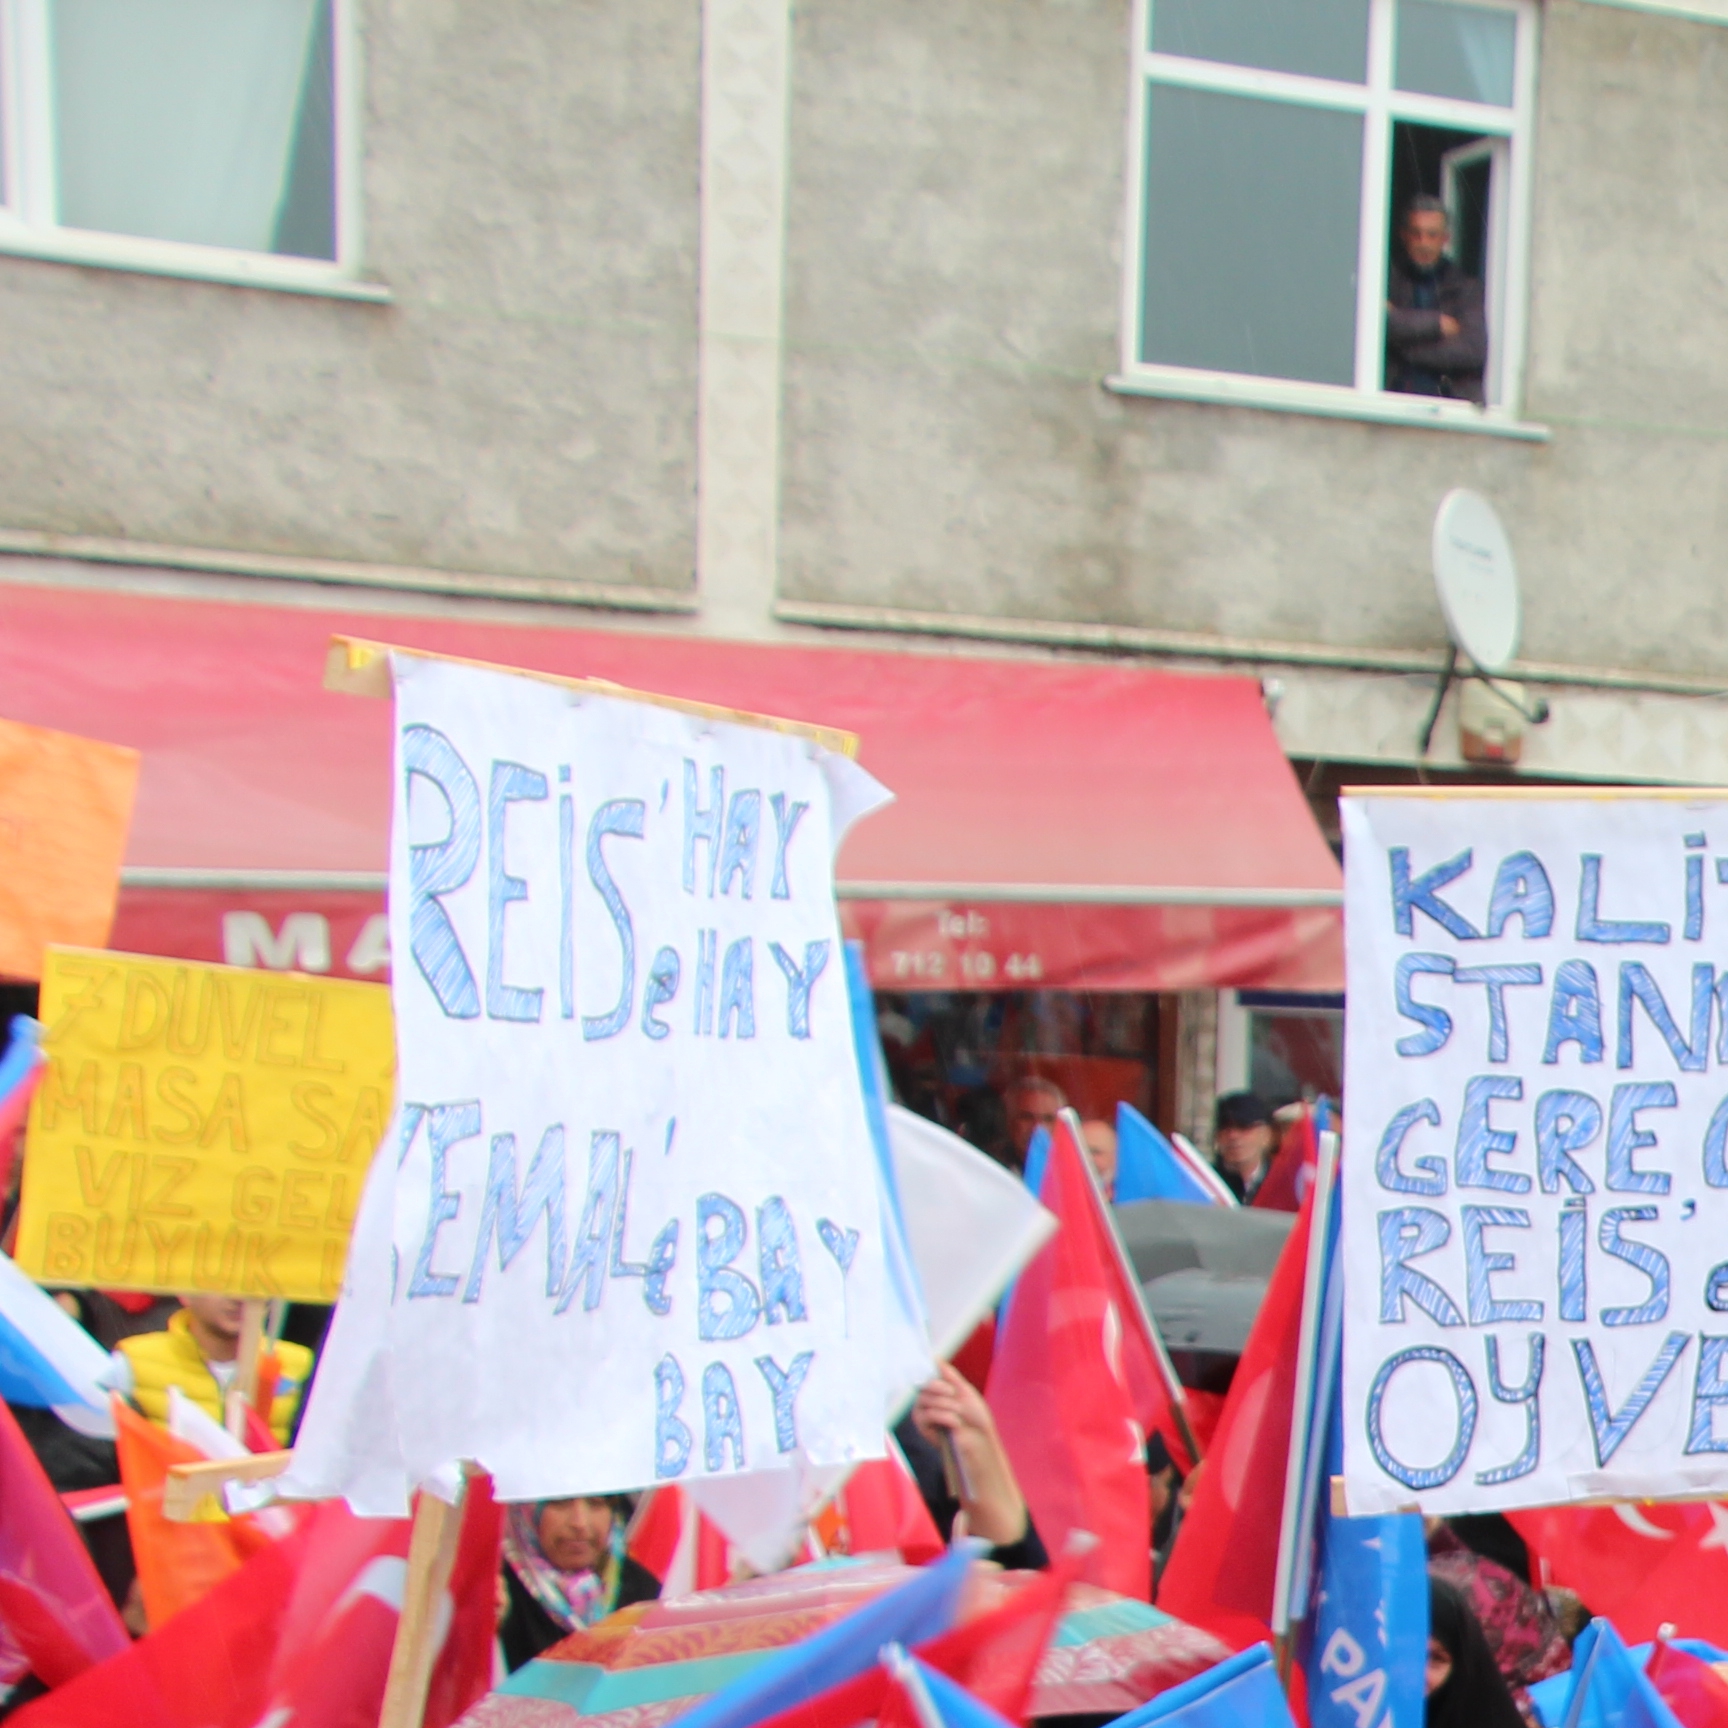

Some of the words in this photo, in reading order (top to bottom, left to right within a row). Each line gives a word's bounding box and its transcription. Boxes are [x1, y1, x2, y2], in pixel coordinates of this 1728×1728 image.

[683, 758, 809, 900] HAY
[696, 928, 829, 1038] HAY
[892, 951, 943, 978] 712
[959, 952, 995, 979] 10
[1005, 953, 1043, 980] 44
[696, 1193, 860, 1341] BAY
[655, 1351, 815, 1479] BAY
